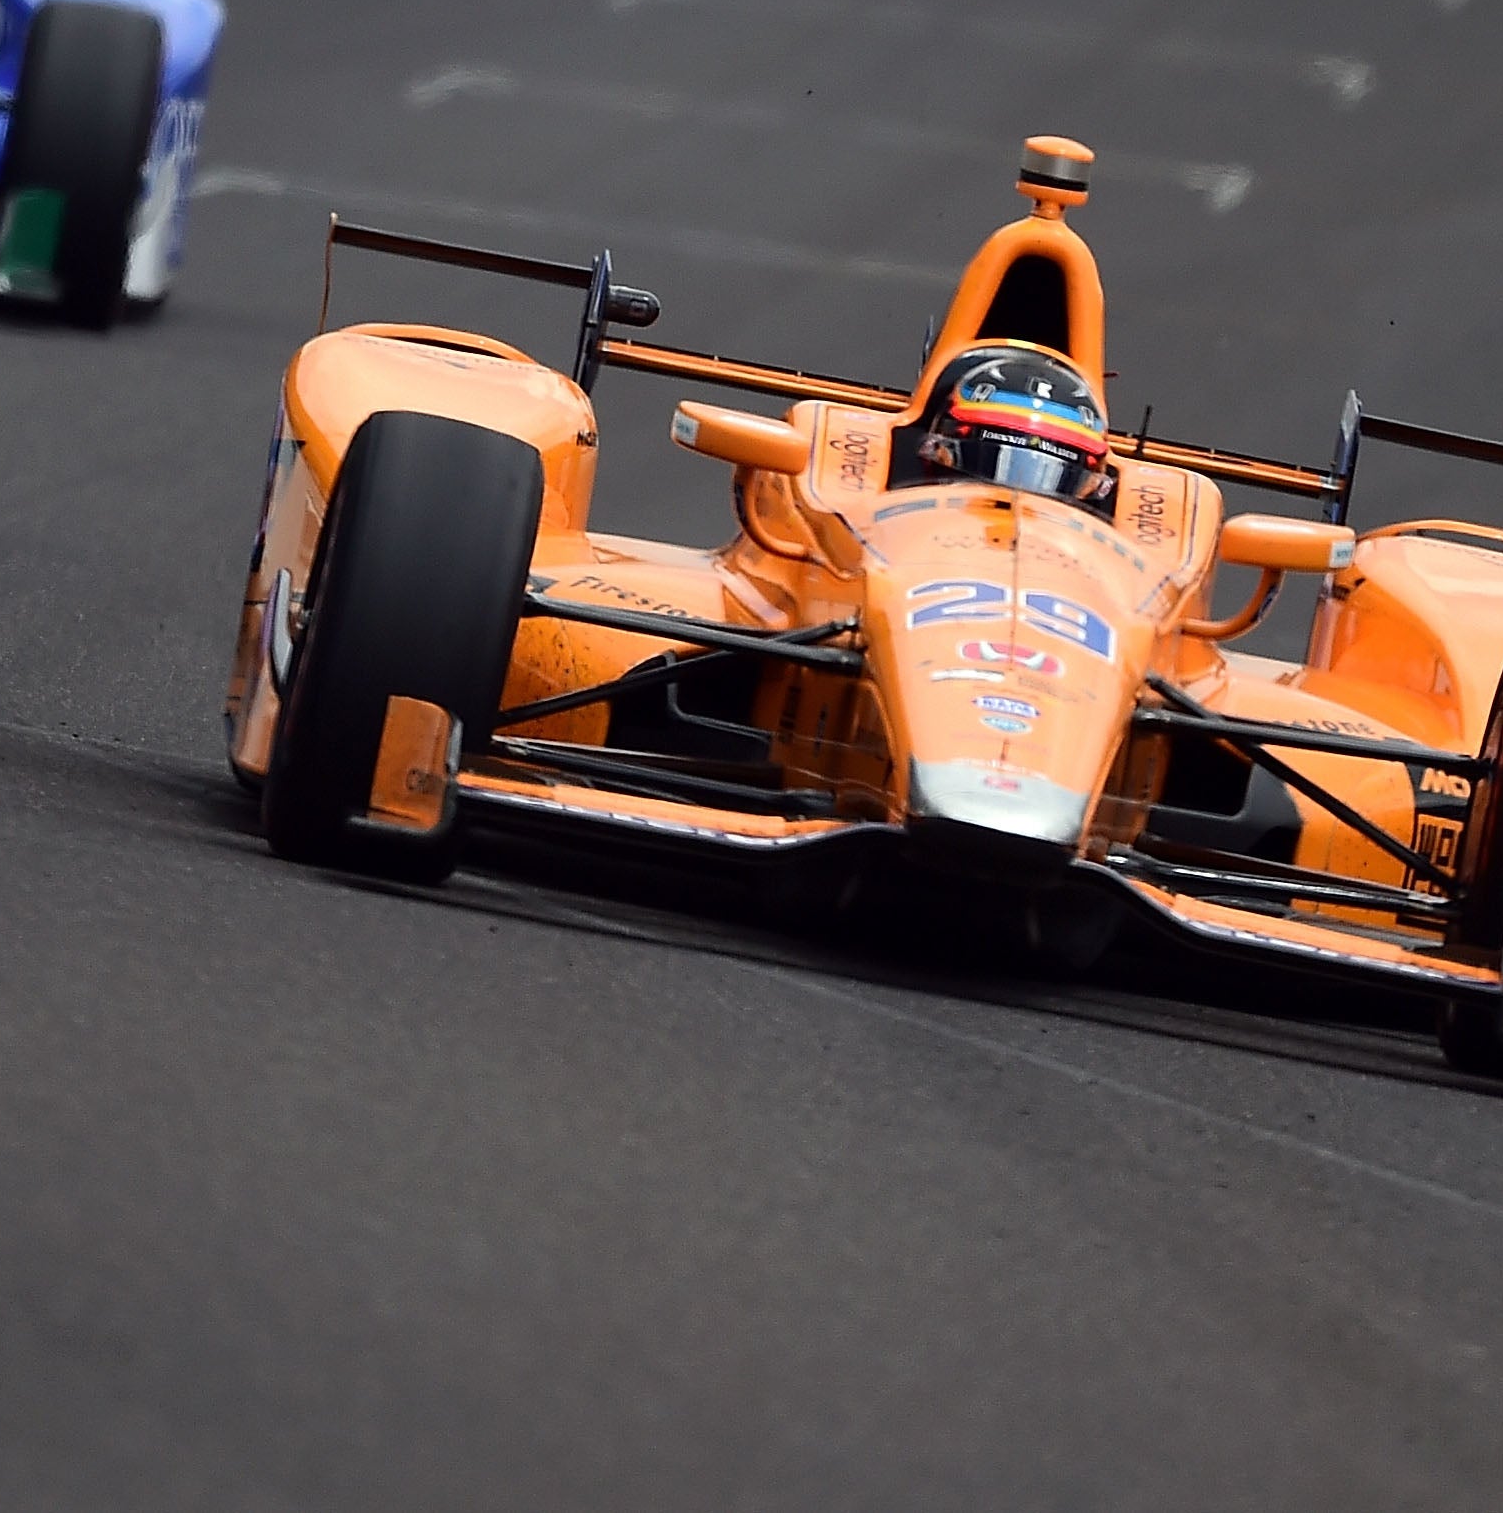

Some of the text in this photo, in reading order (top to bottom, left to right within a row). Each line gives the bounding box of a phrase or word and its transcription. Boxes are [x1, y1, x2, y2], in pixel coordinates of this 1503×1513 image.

[829, 429, 883, 492] logitech
[570, 576, 705, 620] Firesto
[905, 579, 1116, 664] 29
